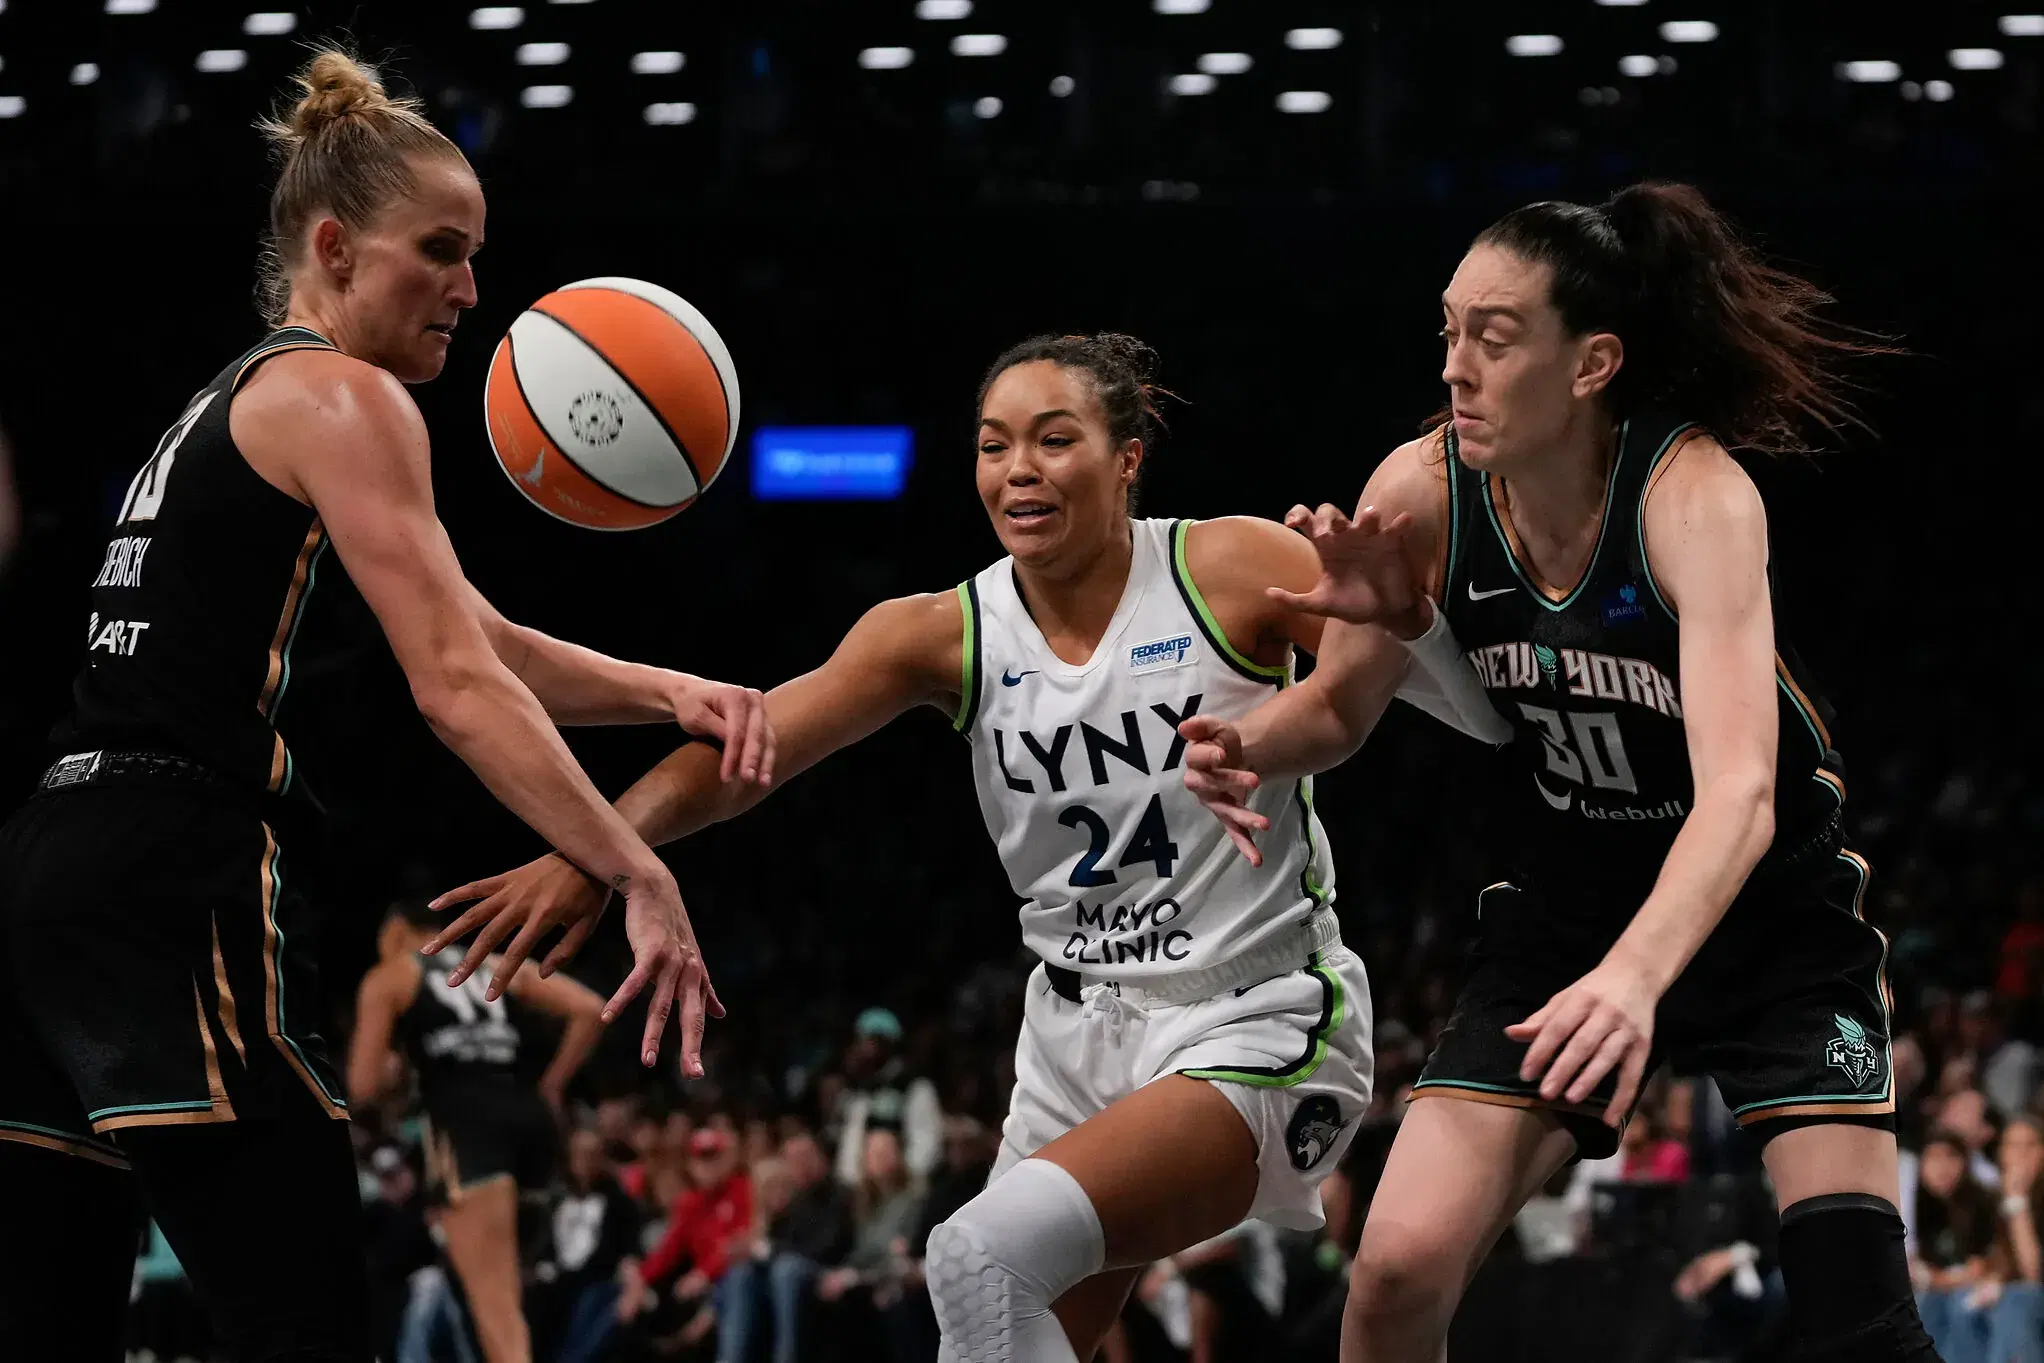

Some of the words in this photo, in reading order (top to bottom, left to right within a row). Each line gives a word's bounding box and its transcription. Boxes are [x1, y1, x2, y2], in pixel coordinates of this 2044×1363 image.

[1130, 652, 1174, 667] INSURANCE
[1131, 636, 1192, 659] FEDERATED
[1467, 641, 1540, 688] NEW
[1560, 648, 1683, 719] YORK
[993, 694, 1203, 793] LYNX
[1516, 701, 1638, 794] 30
[1580, 799, 1684, 820] Webull
[1057, 793, 1179, 887] 24
[1076, 898, 1181, 932] MAYO
[1063, 930, 1193, 964] CLINIC
